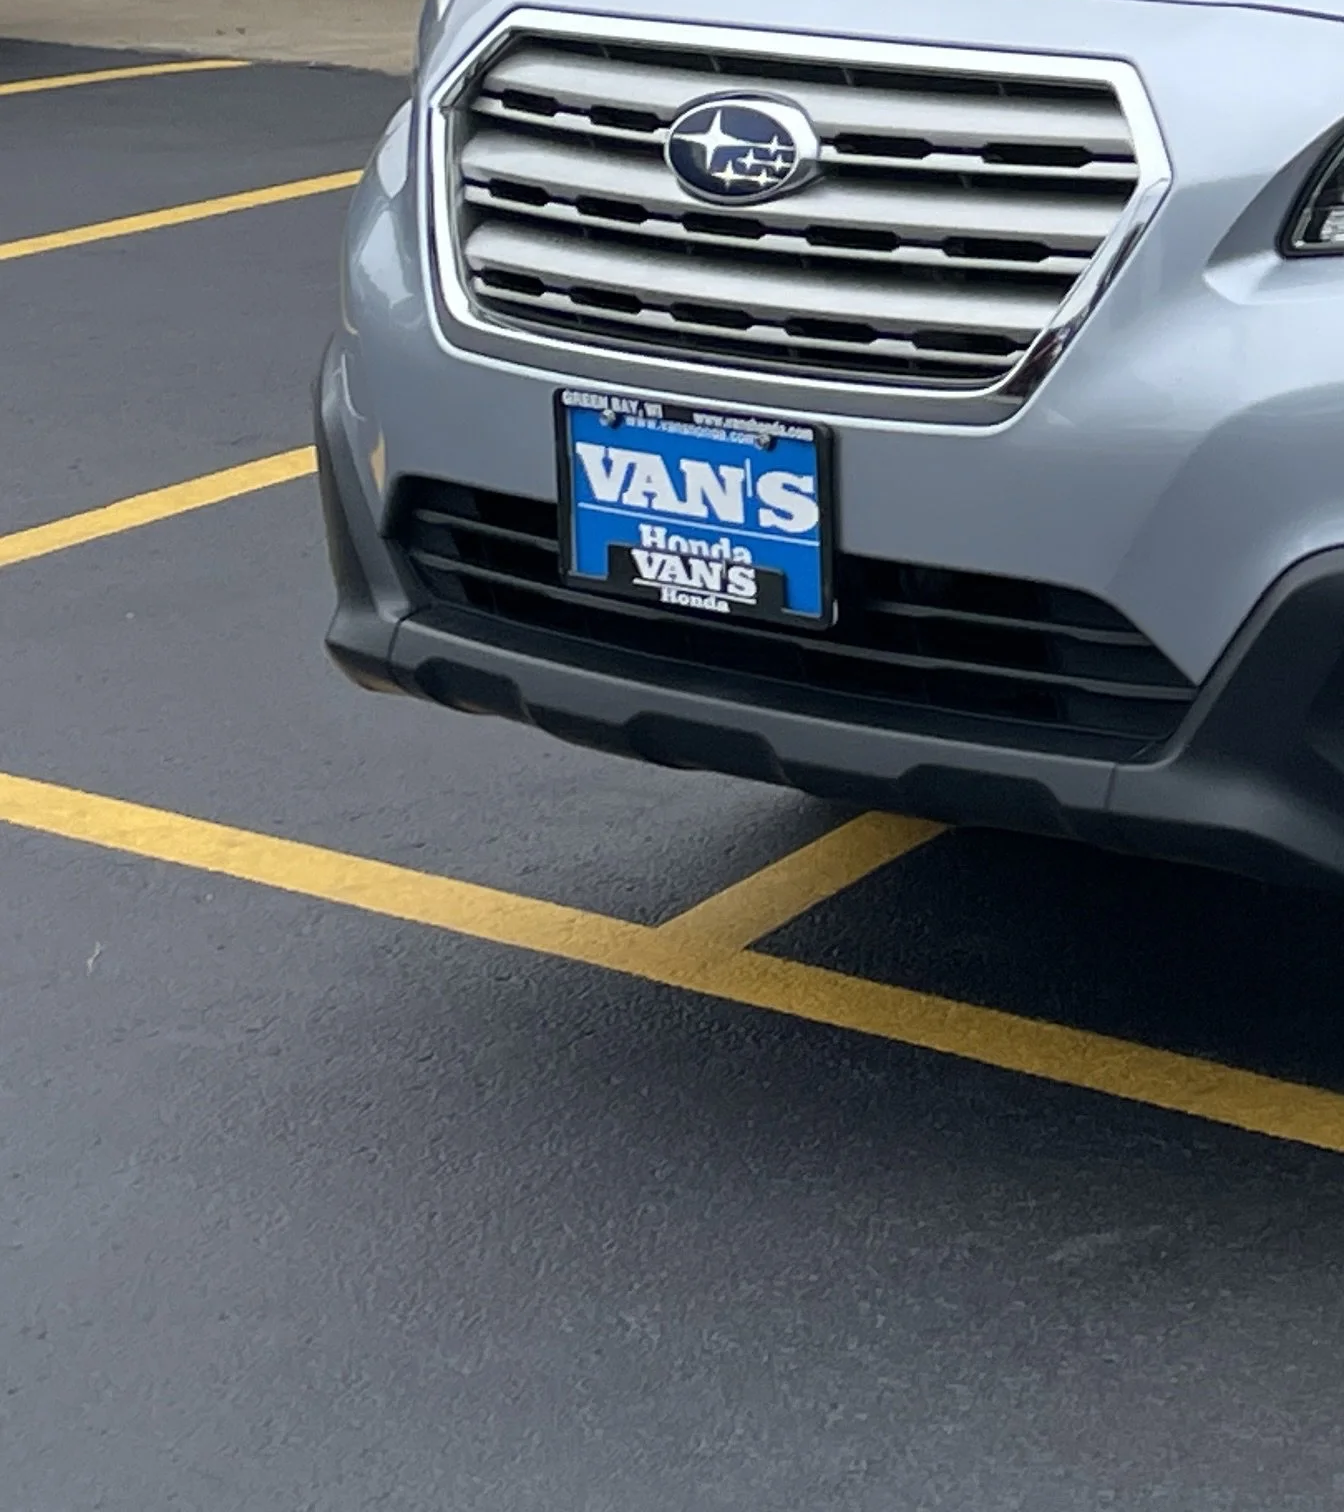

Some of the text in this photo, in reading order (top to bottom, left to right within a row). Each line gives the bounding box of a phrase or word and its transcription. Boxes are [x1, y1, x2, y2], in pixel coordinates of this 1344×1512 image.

[562, 389, 609, 410] GREEN
[644, 401, 663, 419] WI
[575, 441, 820, 534] VAN'S
[638, 523, 753, 564] Honda
[630, 548, 758, 597] VAN'S
[660, 586, 731, 613] Honda
